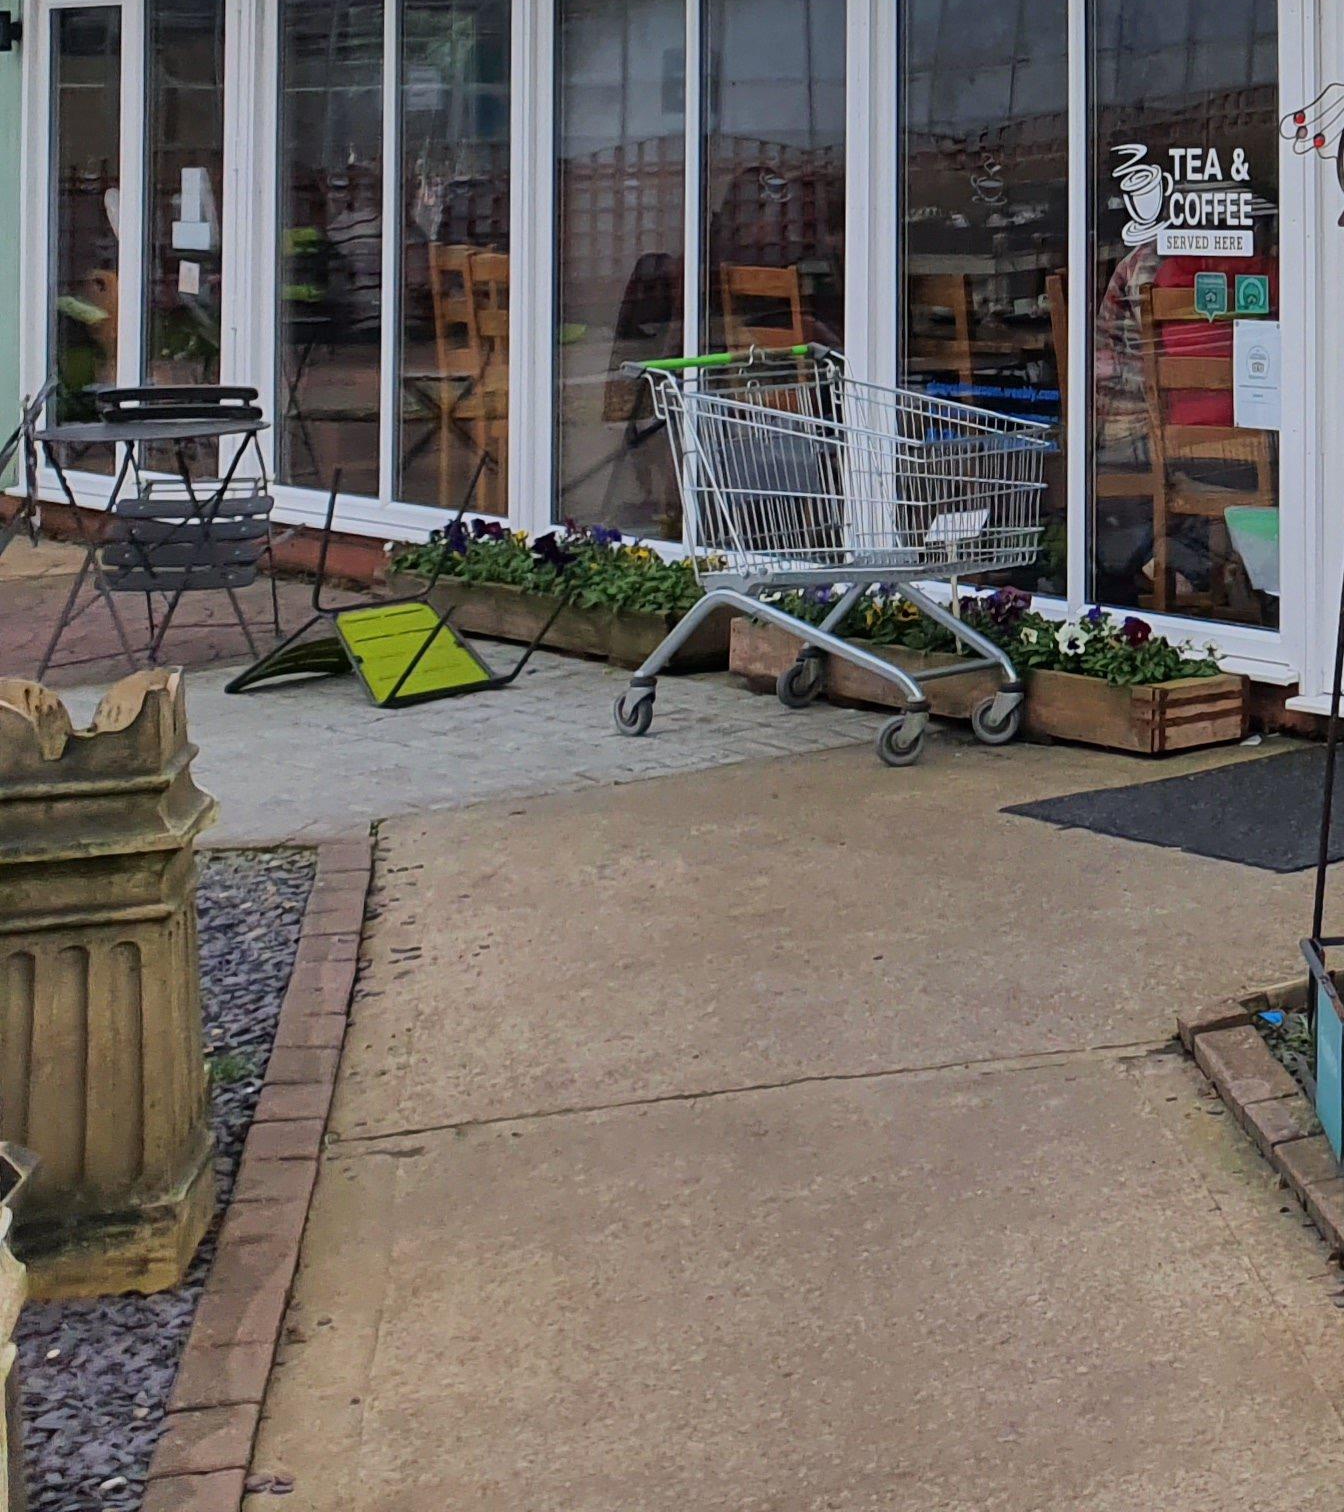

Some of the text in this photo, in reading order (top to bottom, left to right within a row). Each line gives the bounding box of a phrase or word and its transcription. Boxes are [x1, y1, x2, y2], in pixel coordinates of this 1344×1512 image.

[1168, 147, 1251, 182] TEA &
[1169, 192, 1254, 226] COFFEE
[1167, 235, 1243, 250] SERVED HERE
